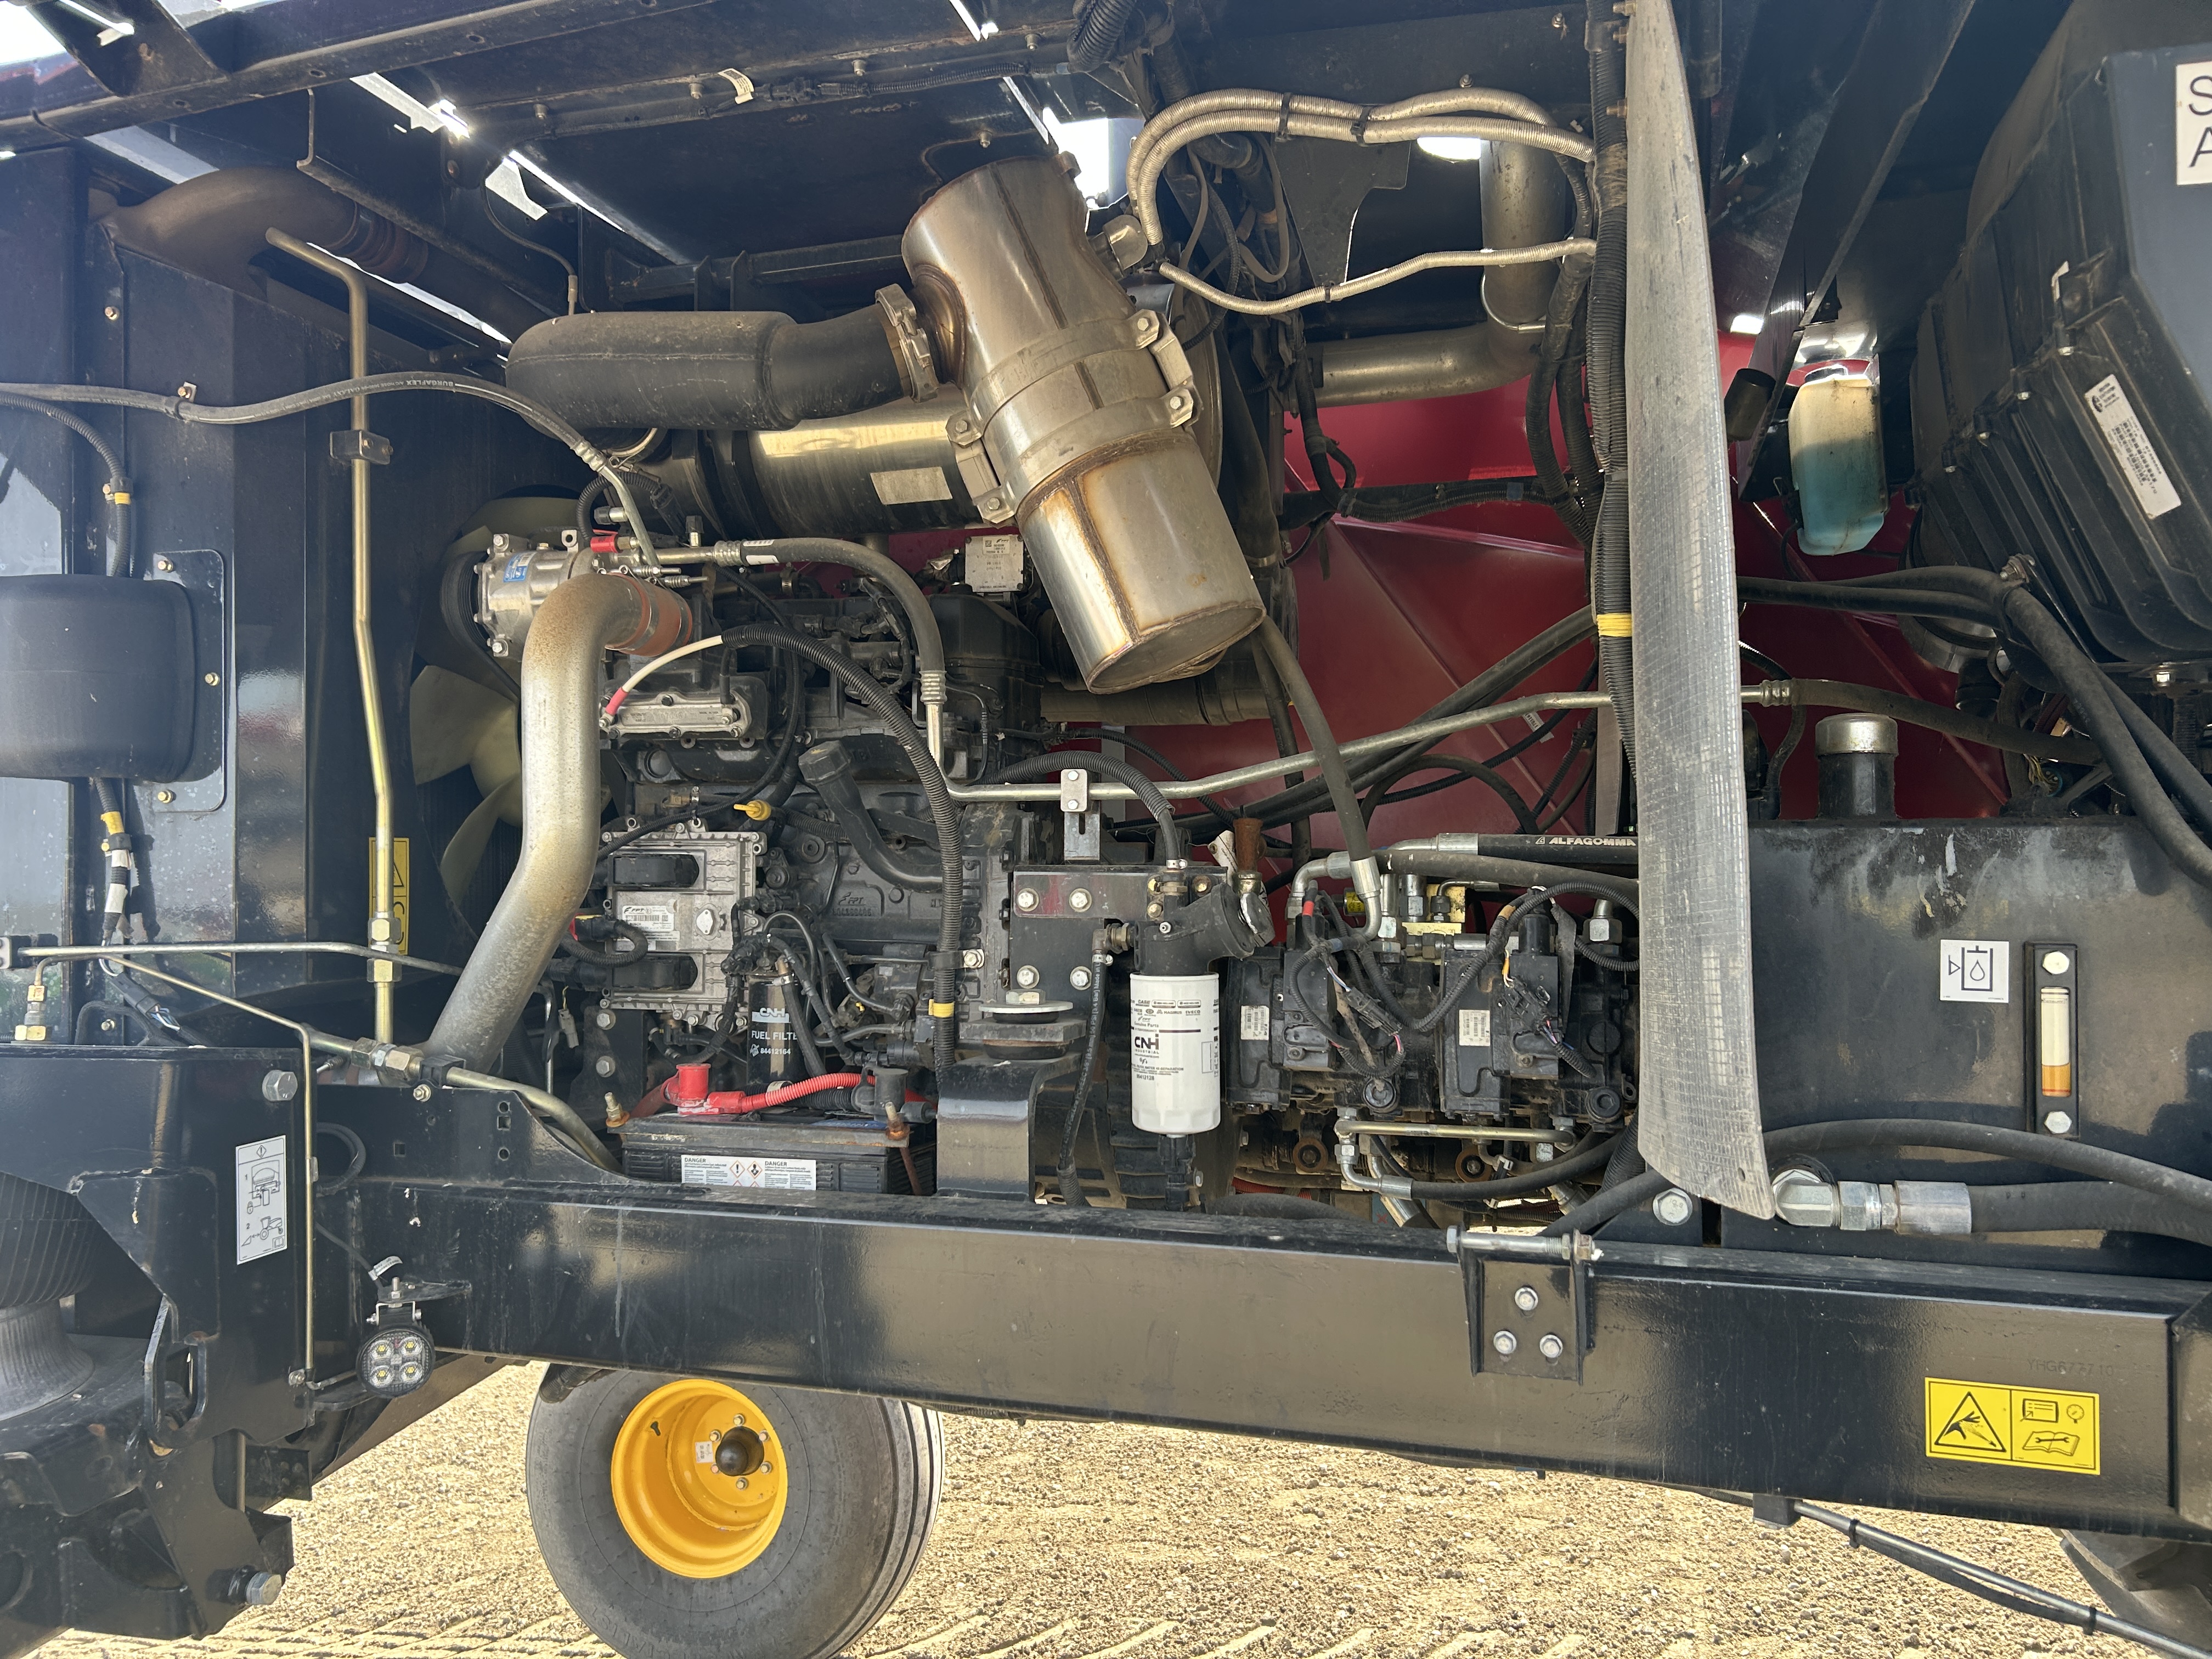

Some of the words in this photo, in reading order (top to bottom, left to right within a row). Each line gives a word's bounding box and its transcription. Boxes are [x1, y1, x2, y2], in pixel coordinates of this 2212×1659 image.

[2188, 75, 2212, 116] S
[1549, 837, 1636, 846] ALFAGOMMA
[759, 1007, 786, 1017] CNH
[751, 1030, 770, 1040] FUEL
[773, 1032, 798, 1040] FILTE
